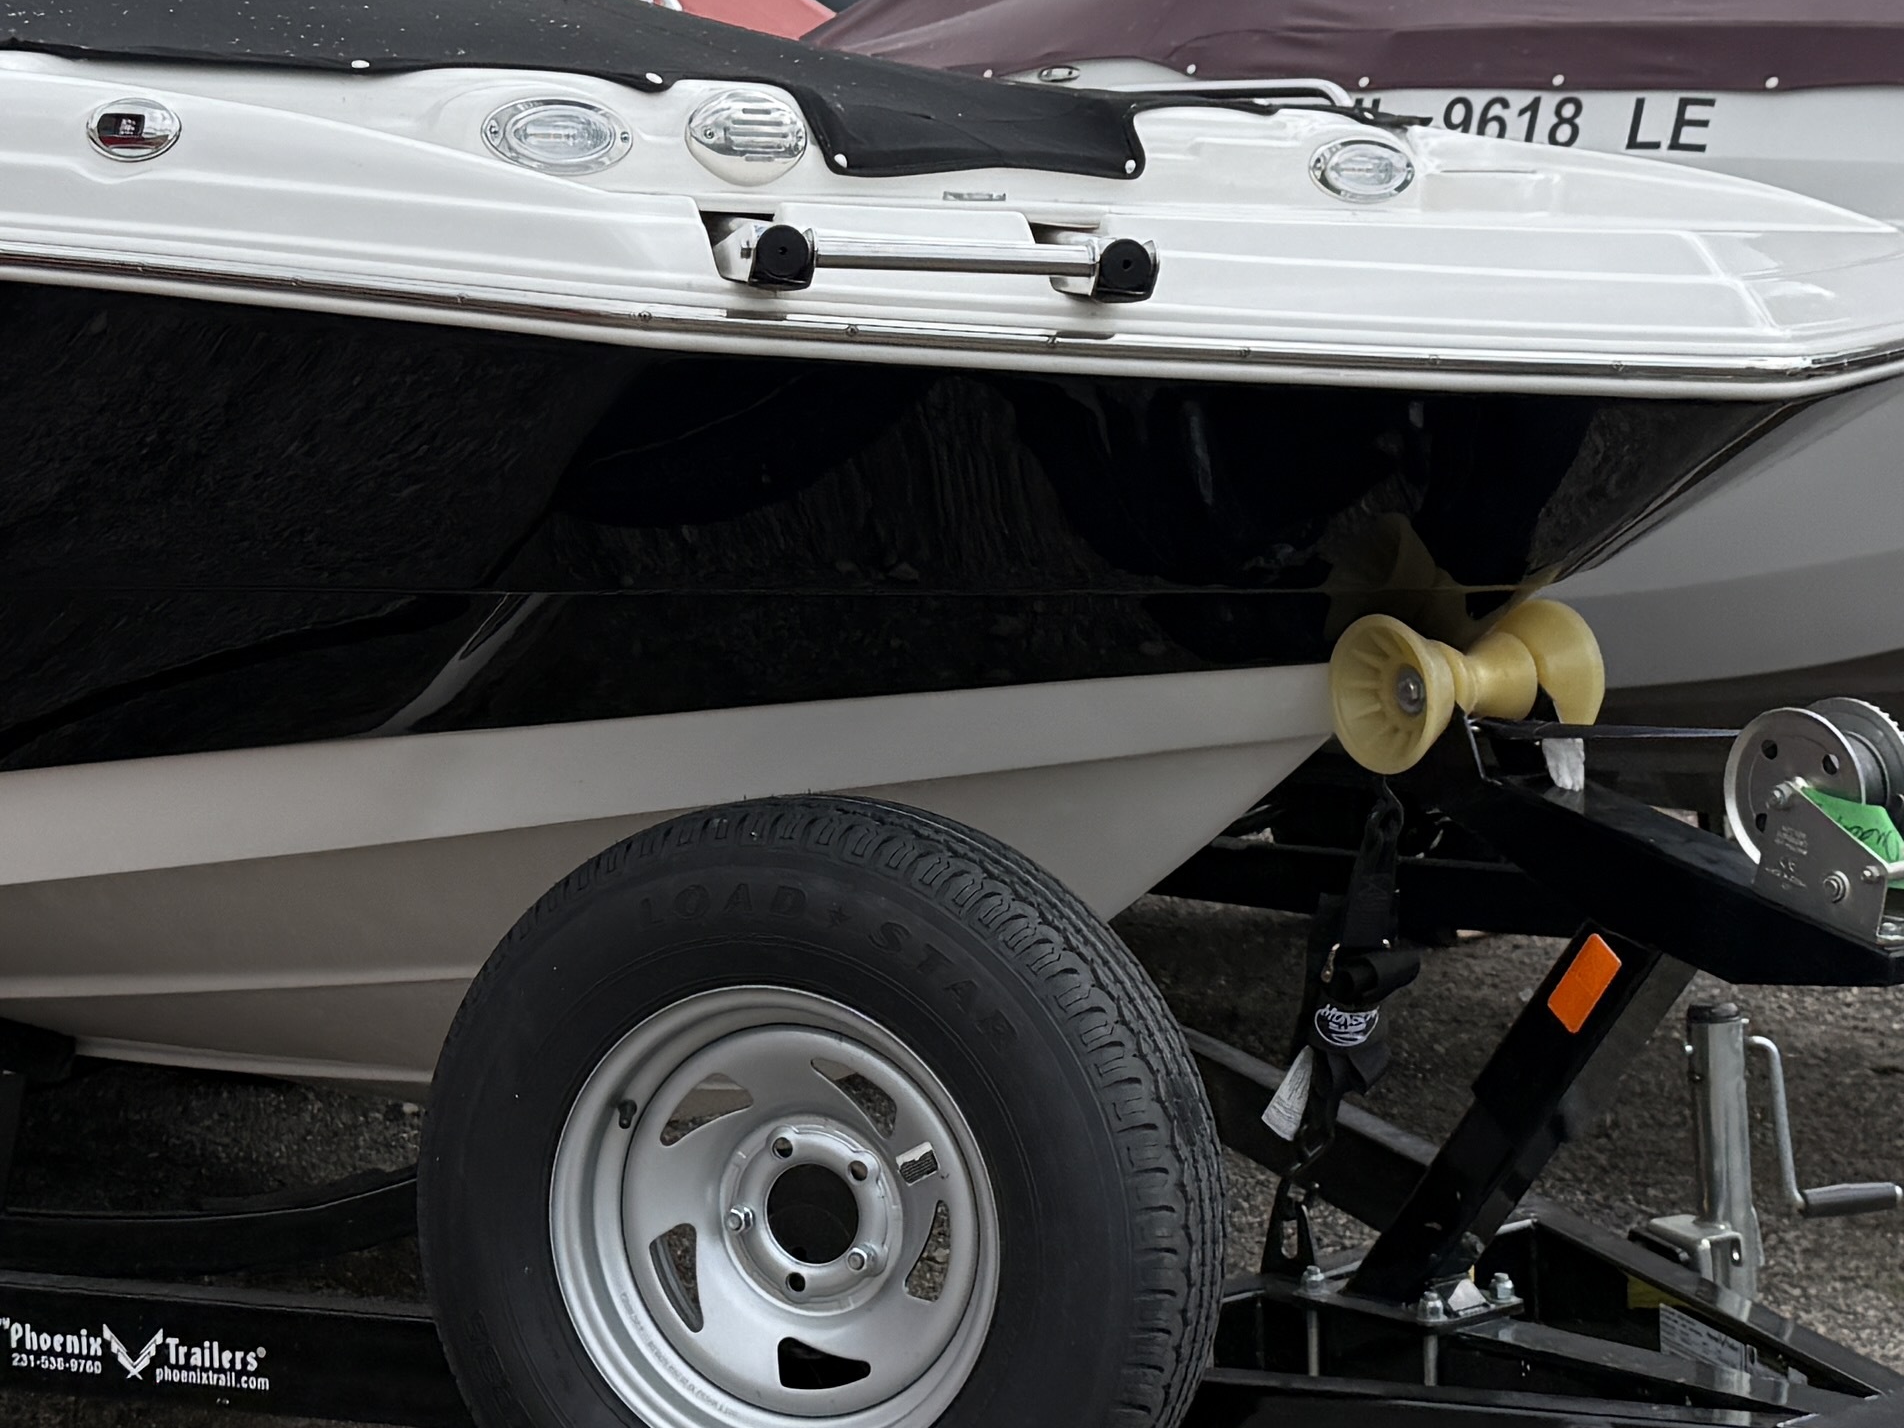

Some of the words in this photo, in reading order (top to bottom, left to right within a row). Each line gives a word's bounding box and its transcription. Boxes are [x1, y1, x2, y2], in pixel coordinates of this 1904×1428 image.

[1443, 96, 1584, 148] 9618
[1625, 97, 1716, 153] LE
[639, 883, 809, 928] LOAD
[867, 921, 1023, 1053] STAR
[10, 1322, 103, 1357] Phoenix
[155, 1366, 270, 1391] phoenixtrail.com
